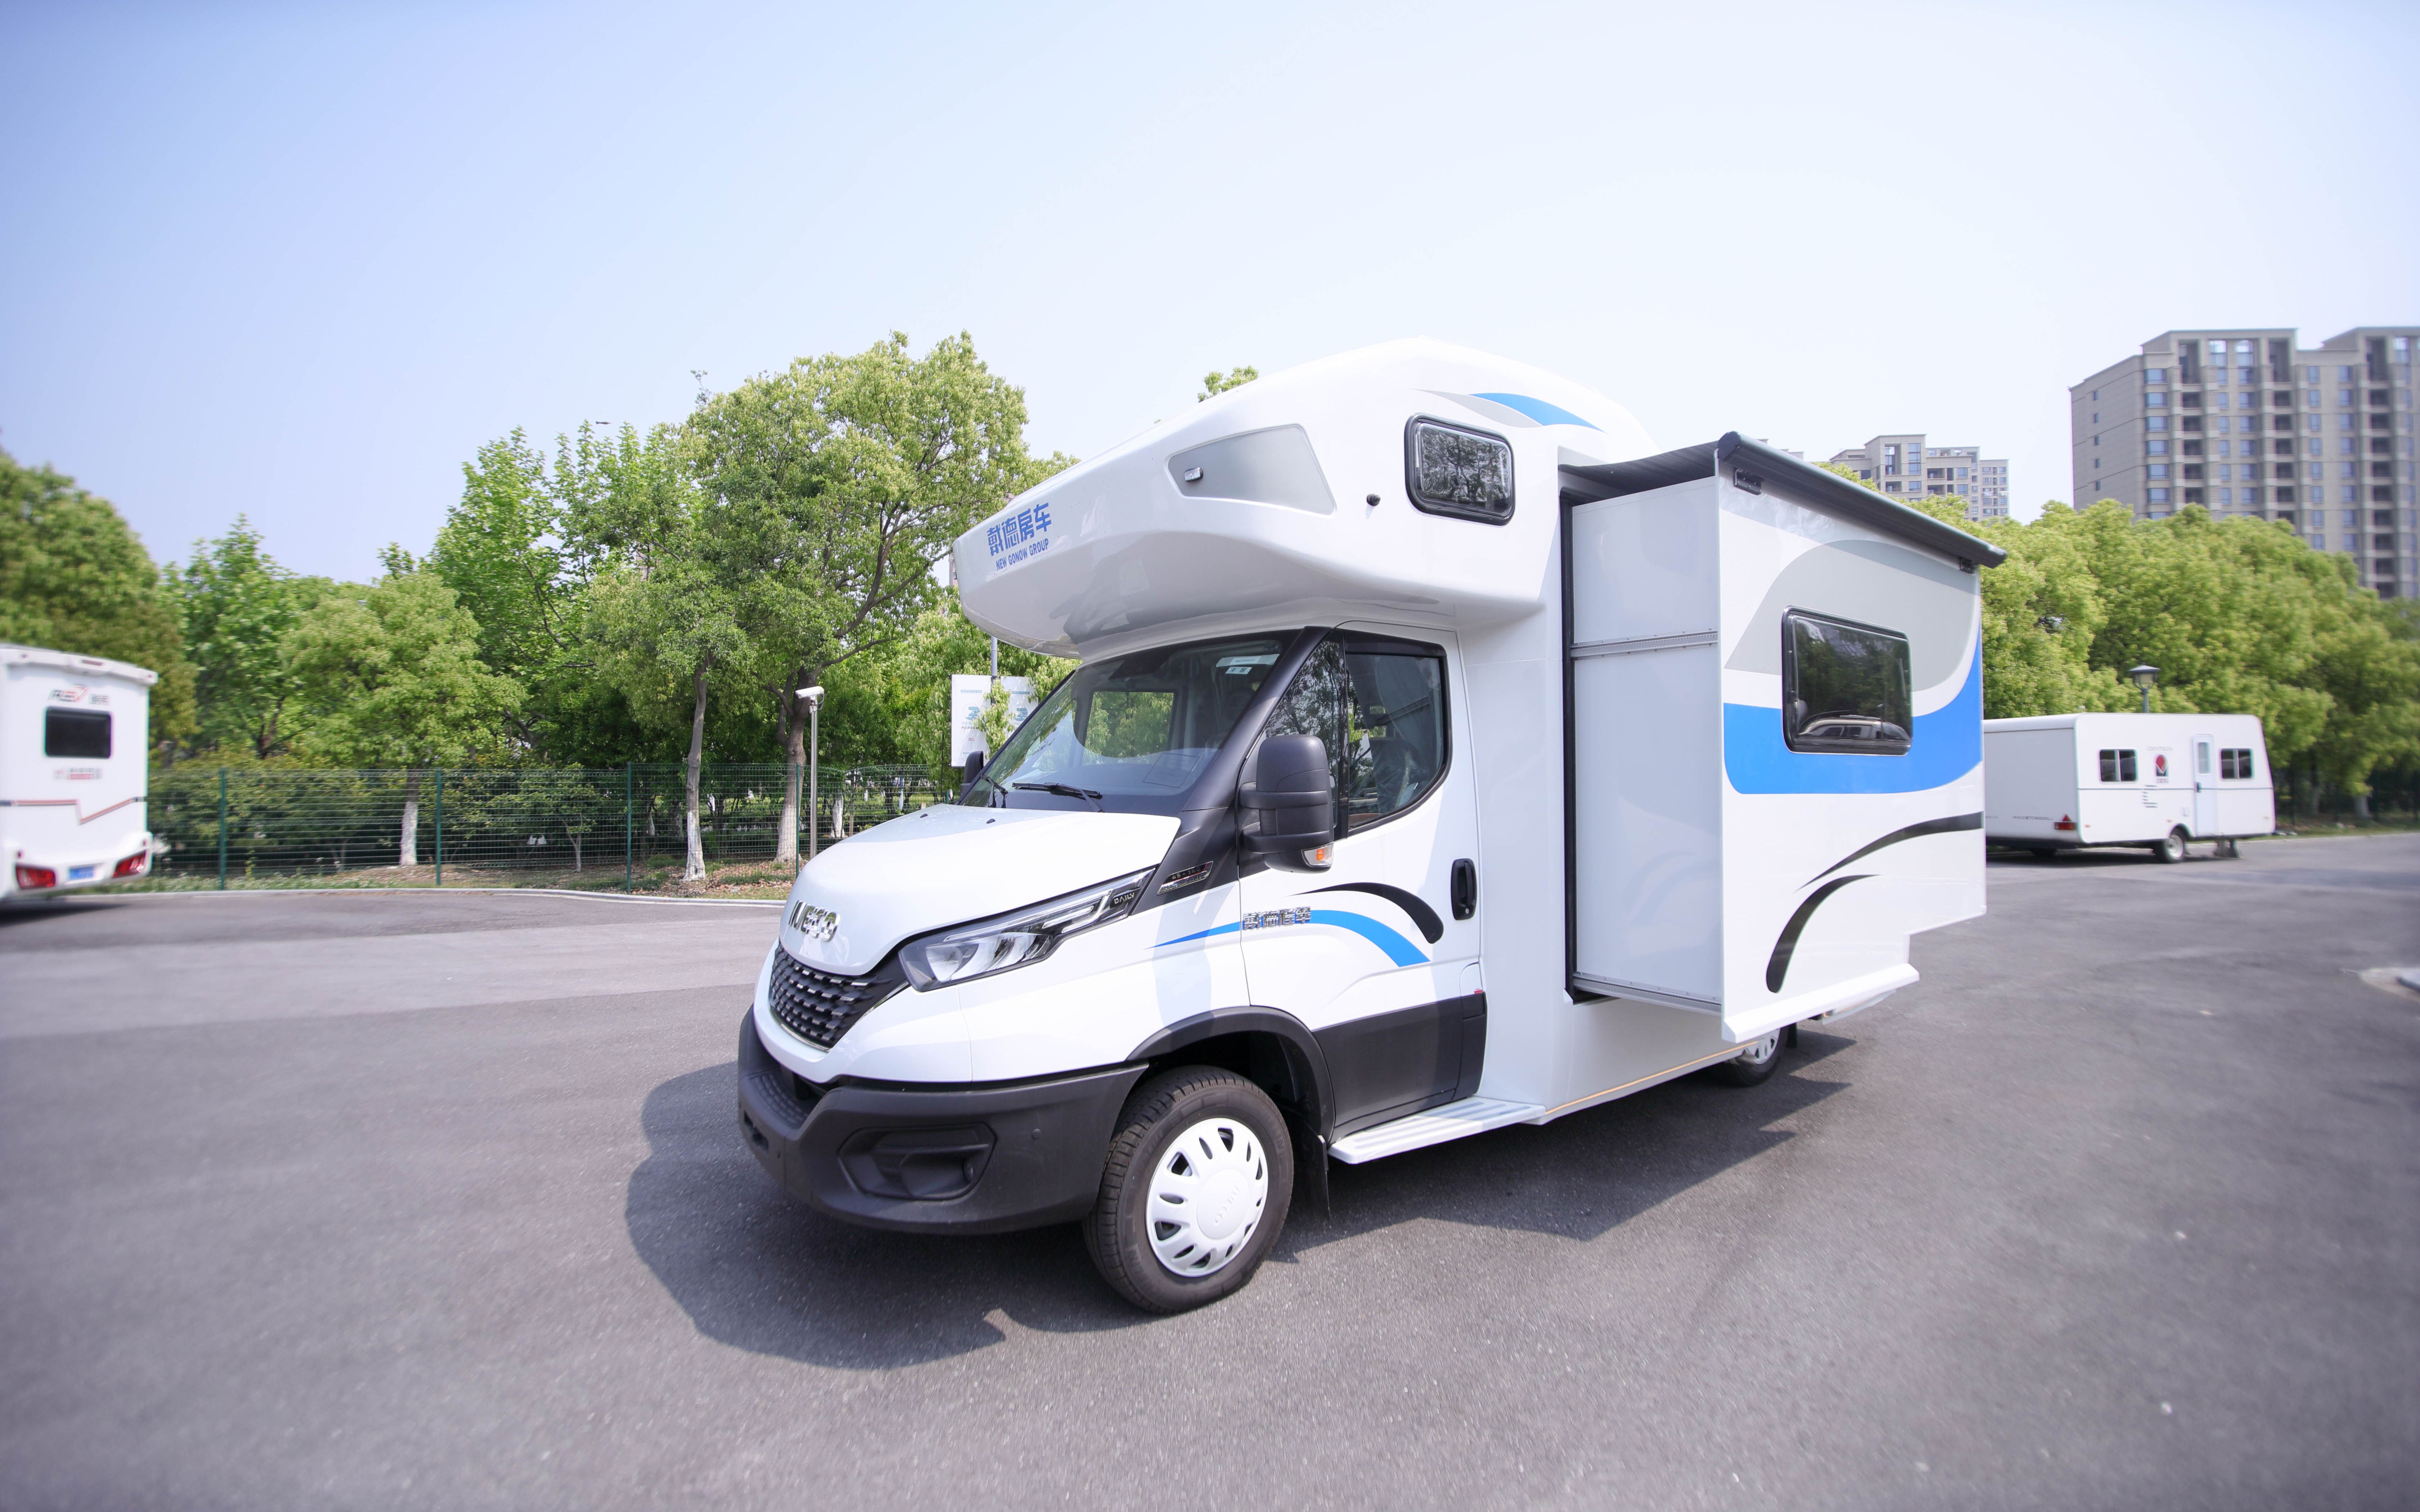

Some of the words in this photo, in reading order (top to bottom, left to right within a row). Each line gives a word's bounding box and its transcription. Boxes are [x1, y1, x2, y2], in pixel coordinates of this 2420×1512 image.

[987, 503, 1052, 556] 戴德房车
[996, 556, 1007, 571] NEW
[1008, 547, 1028, 565] GONOW
[1029, 538, 1049, 556] GROUP
[789, 900, 841, 942] IVECO
